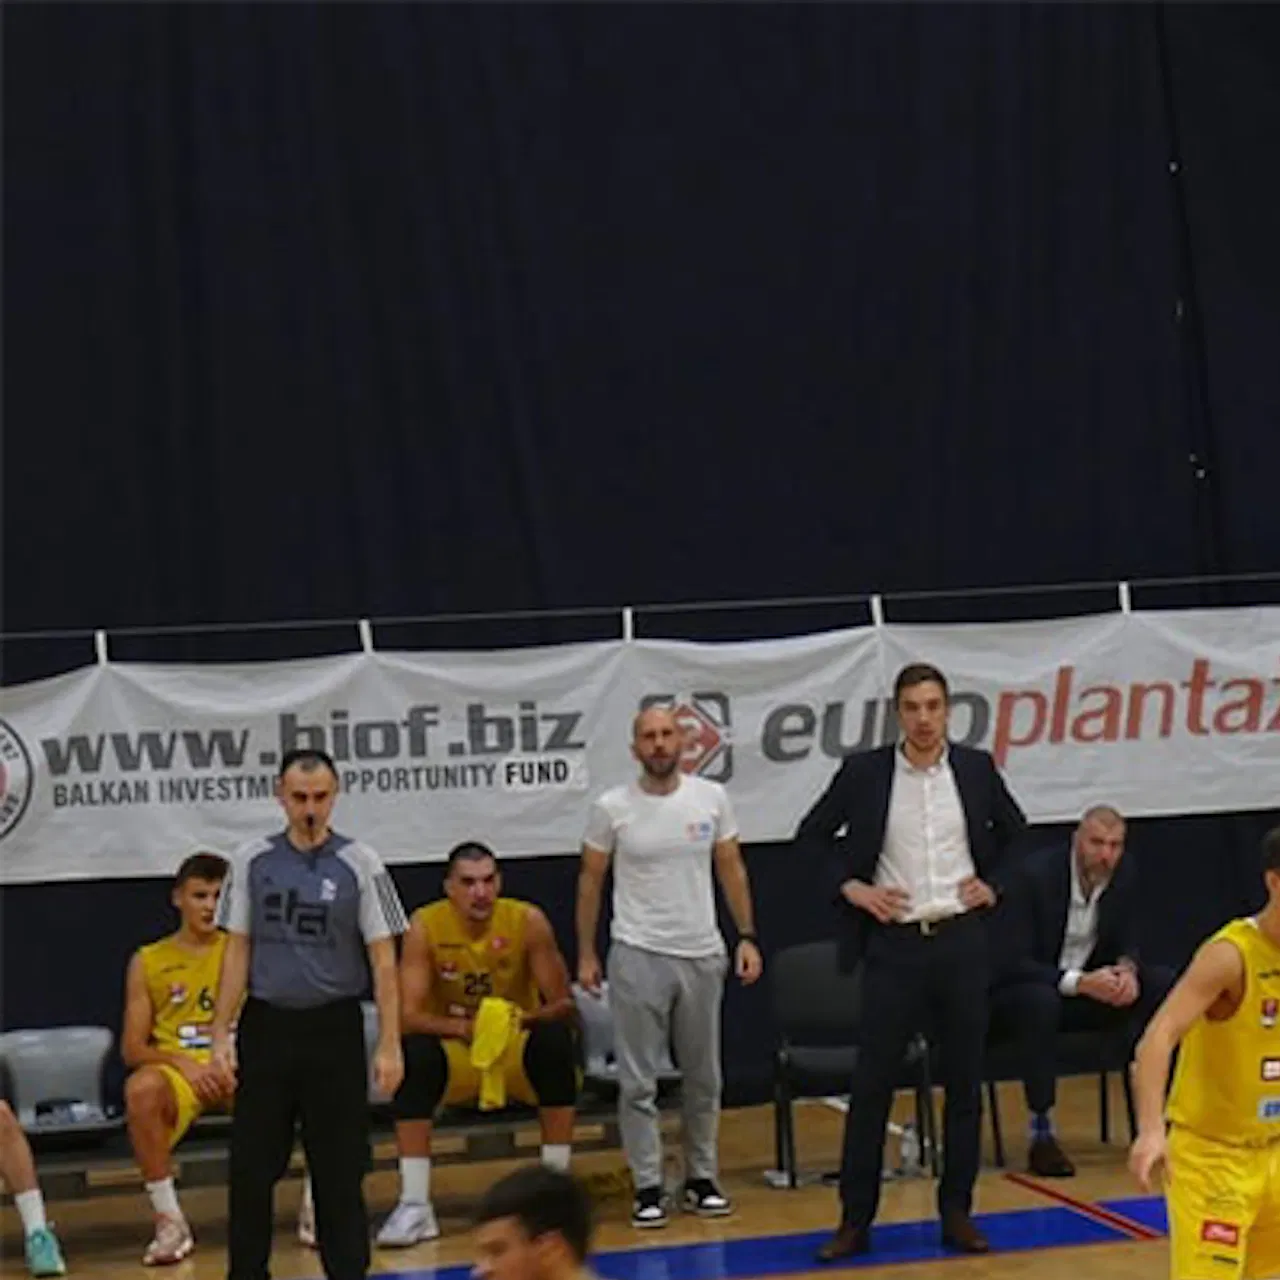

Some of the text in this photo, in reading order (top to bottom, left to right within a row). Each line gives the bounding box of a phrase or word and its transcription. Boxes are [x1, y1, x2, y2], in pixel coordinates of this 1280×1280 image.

[54, 759, 570, 808] BALKAN INVESTM PPORTUNITY FUND
[199, 985, 214, 1011] 6
